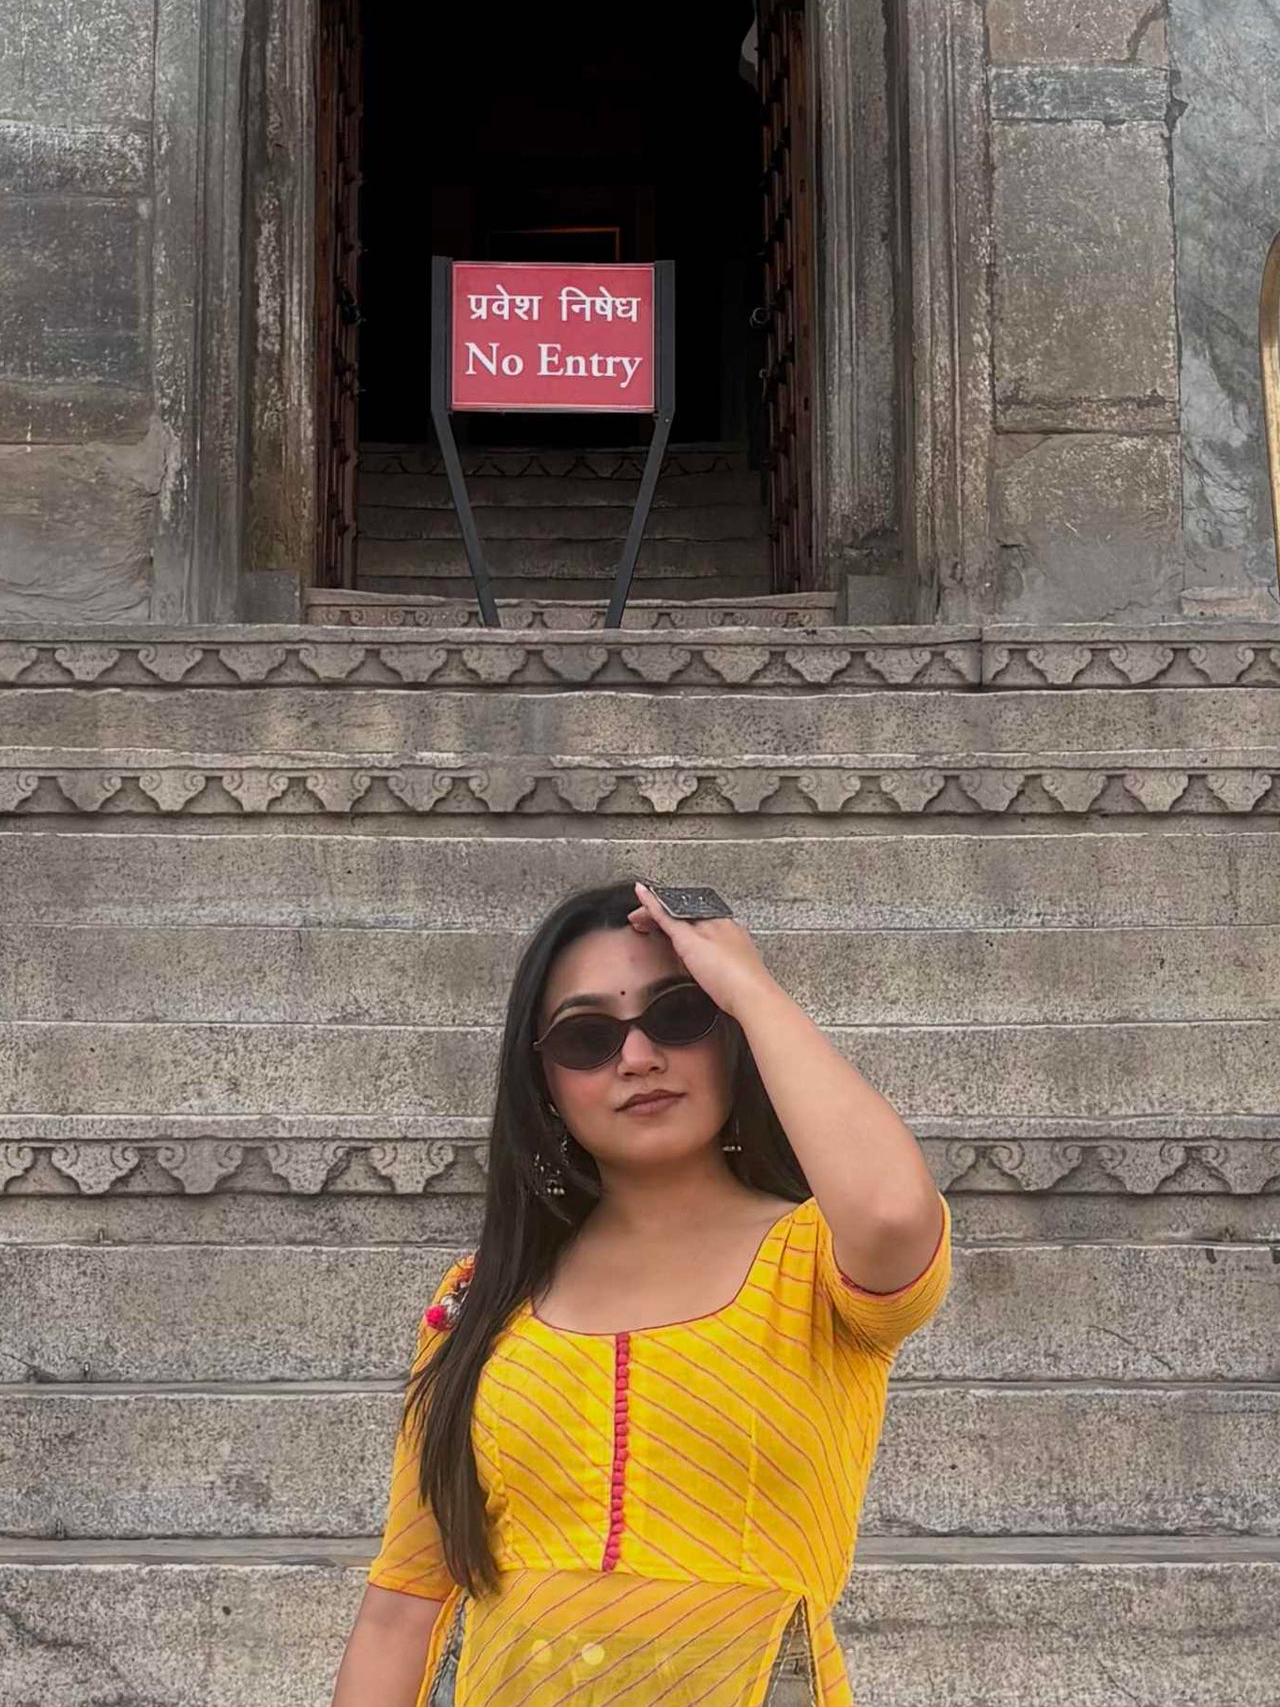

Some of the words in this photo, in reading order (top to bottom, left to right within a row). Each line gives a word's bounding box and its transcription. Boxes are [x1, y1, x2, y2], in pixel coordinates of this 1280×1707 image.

[467, 284, 543, 321] प्रवेश
[558, 286, 641, 322] निषेध
[465, 342, 524, 377] No
[537, 343, 643, 388] Entry
